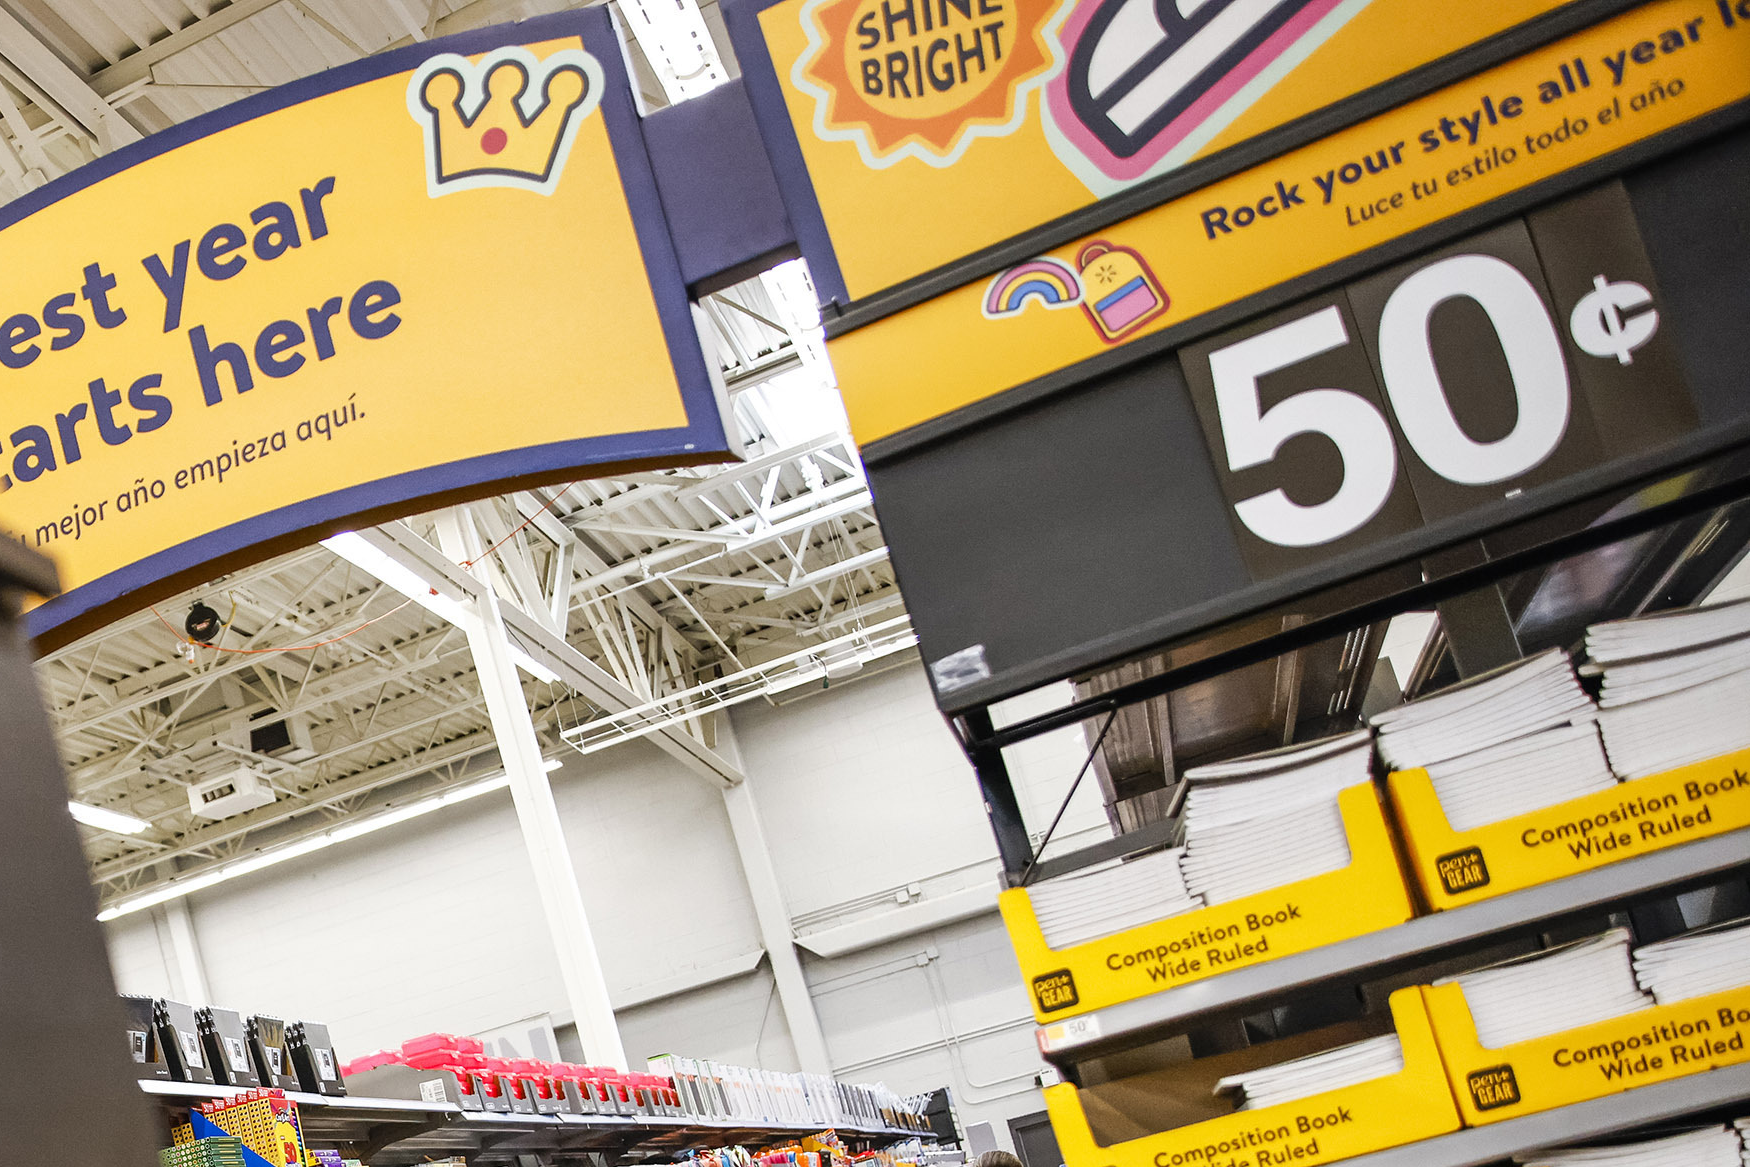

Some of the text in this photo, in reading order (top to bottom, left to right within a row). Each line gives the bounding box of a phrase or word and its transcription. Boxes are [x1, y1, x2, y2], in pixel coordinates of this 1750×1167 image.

[861, 21, 1004, 98] BRIGHT
[1200, 181, 1305, 240] Rock
[1312, 140, 1407, 203] your
[1417, 95, 1523, 154] style
[1538, 57, 1592, 103] all
[1602, 17, 1704, 86] year
[1345, 76, 1686, 228] Luce tu estilo todo el año
[142, 177, 335, 333] year
[188, 280, 402, 406] here
[1209, 253, 1658, 548] 50¢
[32, 503, 108, 549] mejor
[115, 473, 167, 513] año
[174, 431, 287, 487] empieza
[296, 393, 366, 446] aquí.
[1521, 769, 1750, 848] Composition Book
[1567, 804, 1713, 860] Wide Ruled
[1106, 904, 1301, 971] Composition Book
[1146, 936, 1269, 982] Wide Ruled
[1553, 1018, 1711, 1068] Composition
[1600, 1032, 1744, 1081] Wide Ruled
[1296, 1106, 1353, 1134] Book
